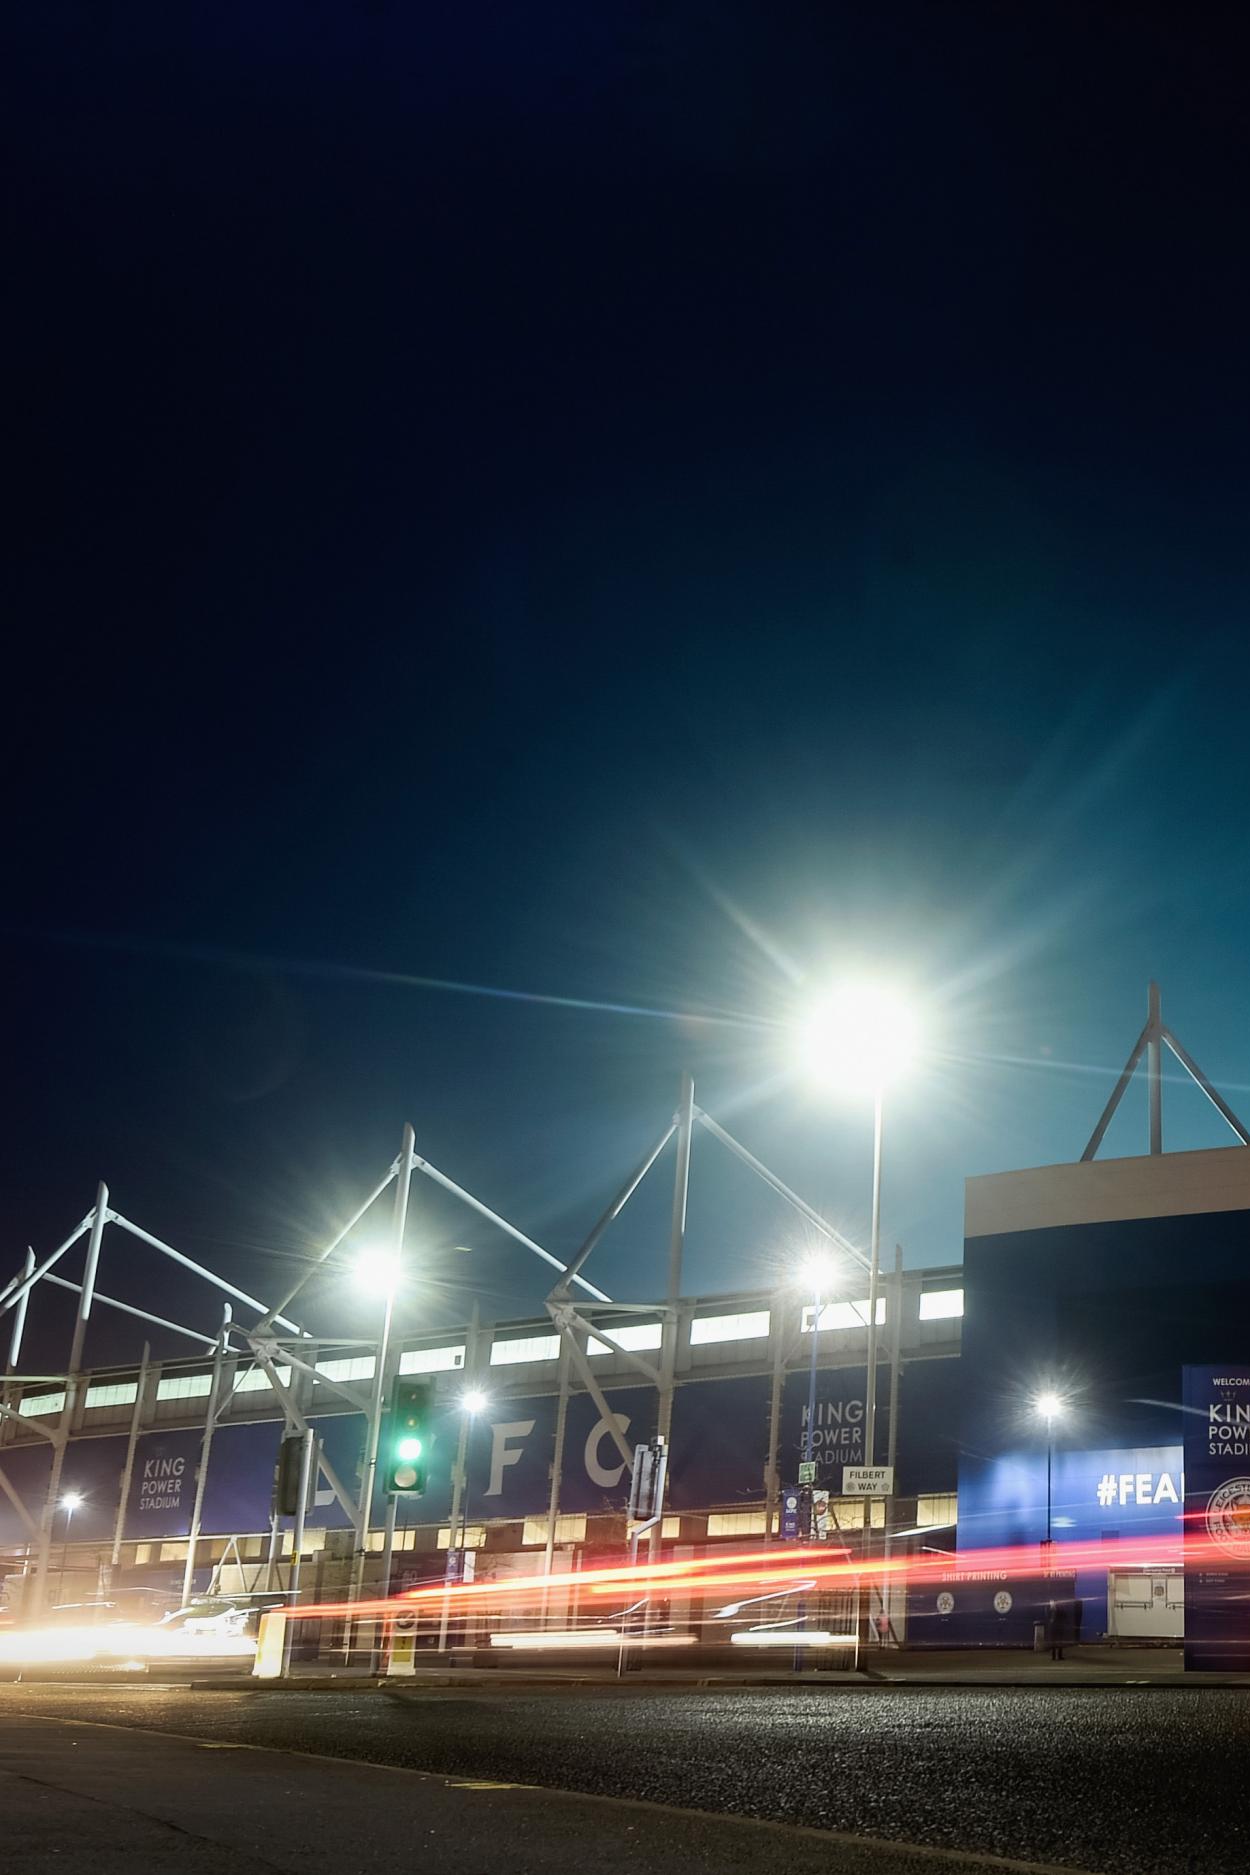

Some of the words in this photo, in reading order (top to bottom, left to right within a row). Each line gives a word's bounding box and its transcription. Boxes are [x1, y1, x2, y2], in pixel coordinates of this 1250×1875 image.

[802, 1400, 863, 1427] KING
[800, 1427, 862, 1448] POWER
[800, 1449, 863, 1464] SADIUM
[144, 1457, 185, 1478] KING
[849, 1470, 887, 1479] FILBERT
[141, 1479, 182, 1495] POWER
[1097, 1472, 1185, 1506] #FEA
[139, 1496, 180, 1510] STADIUM
[942, 1572, 964, 1582] SHIRT
[966, 1570, 1008, 1581] PRINTING
